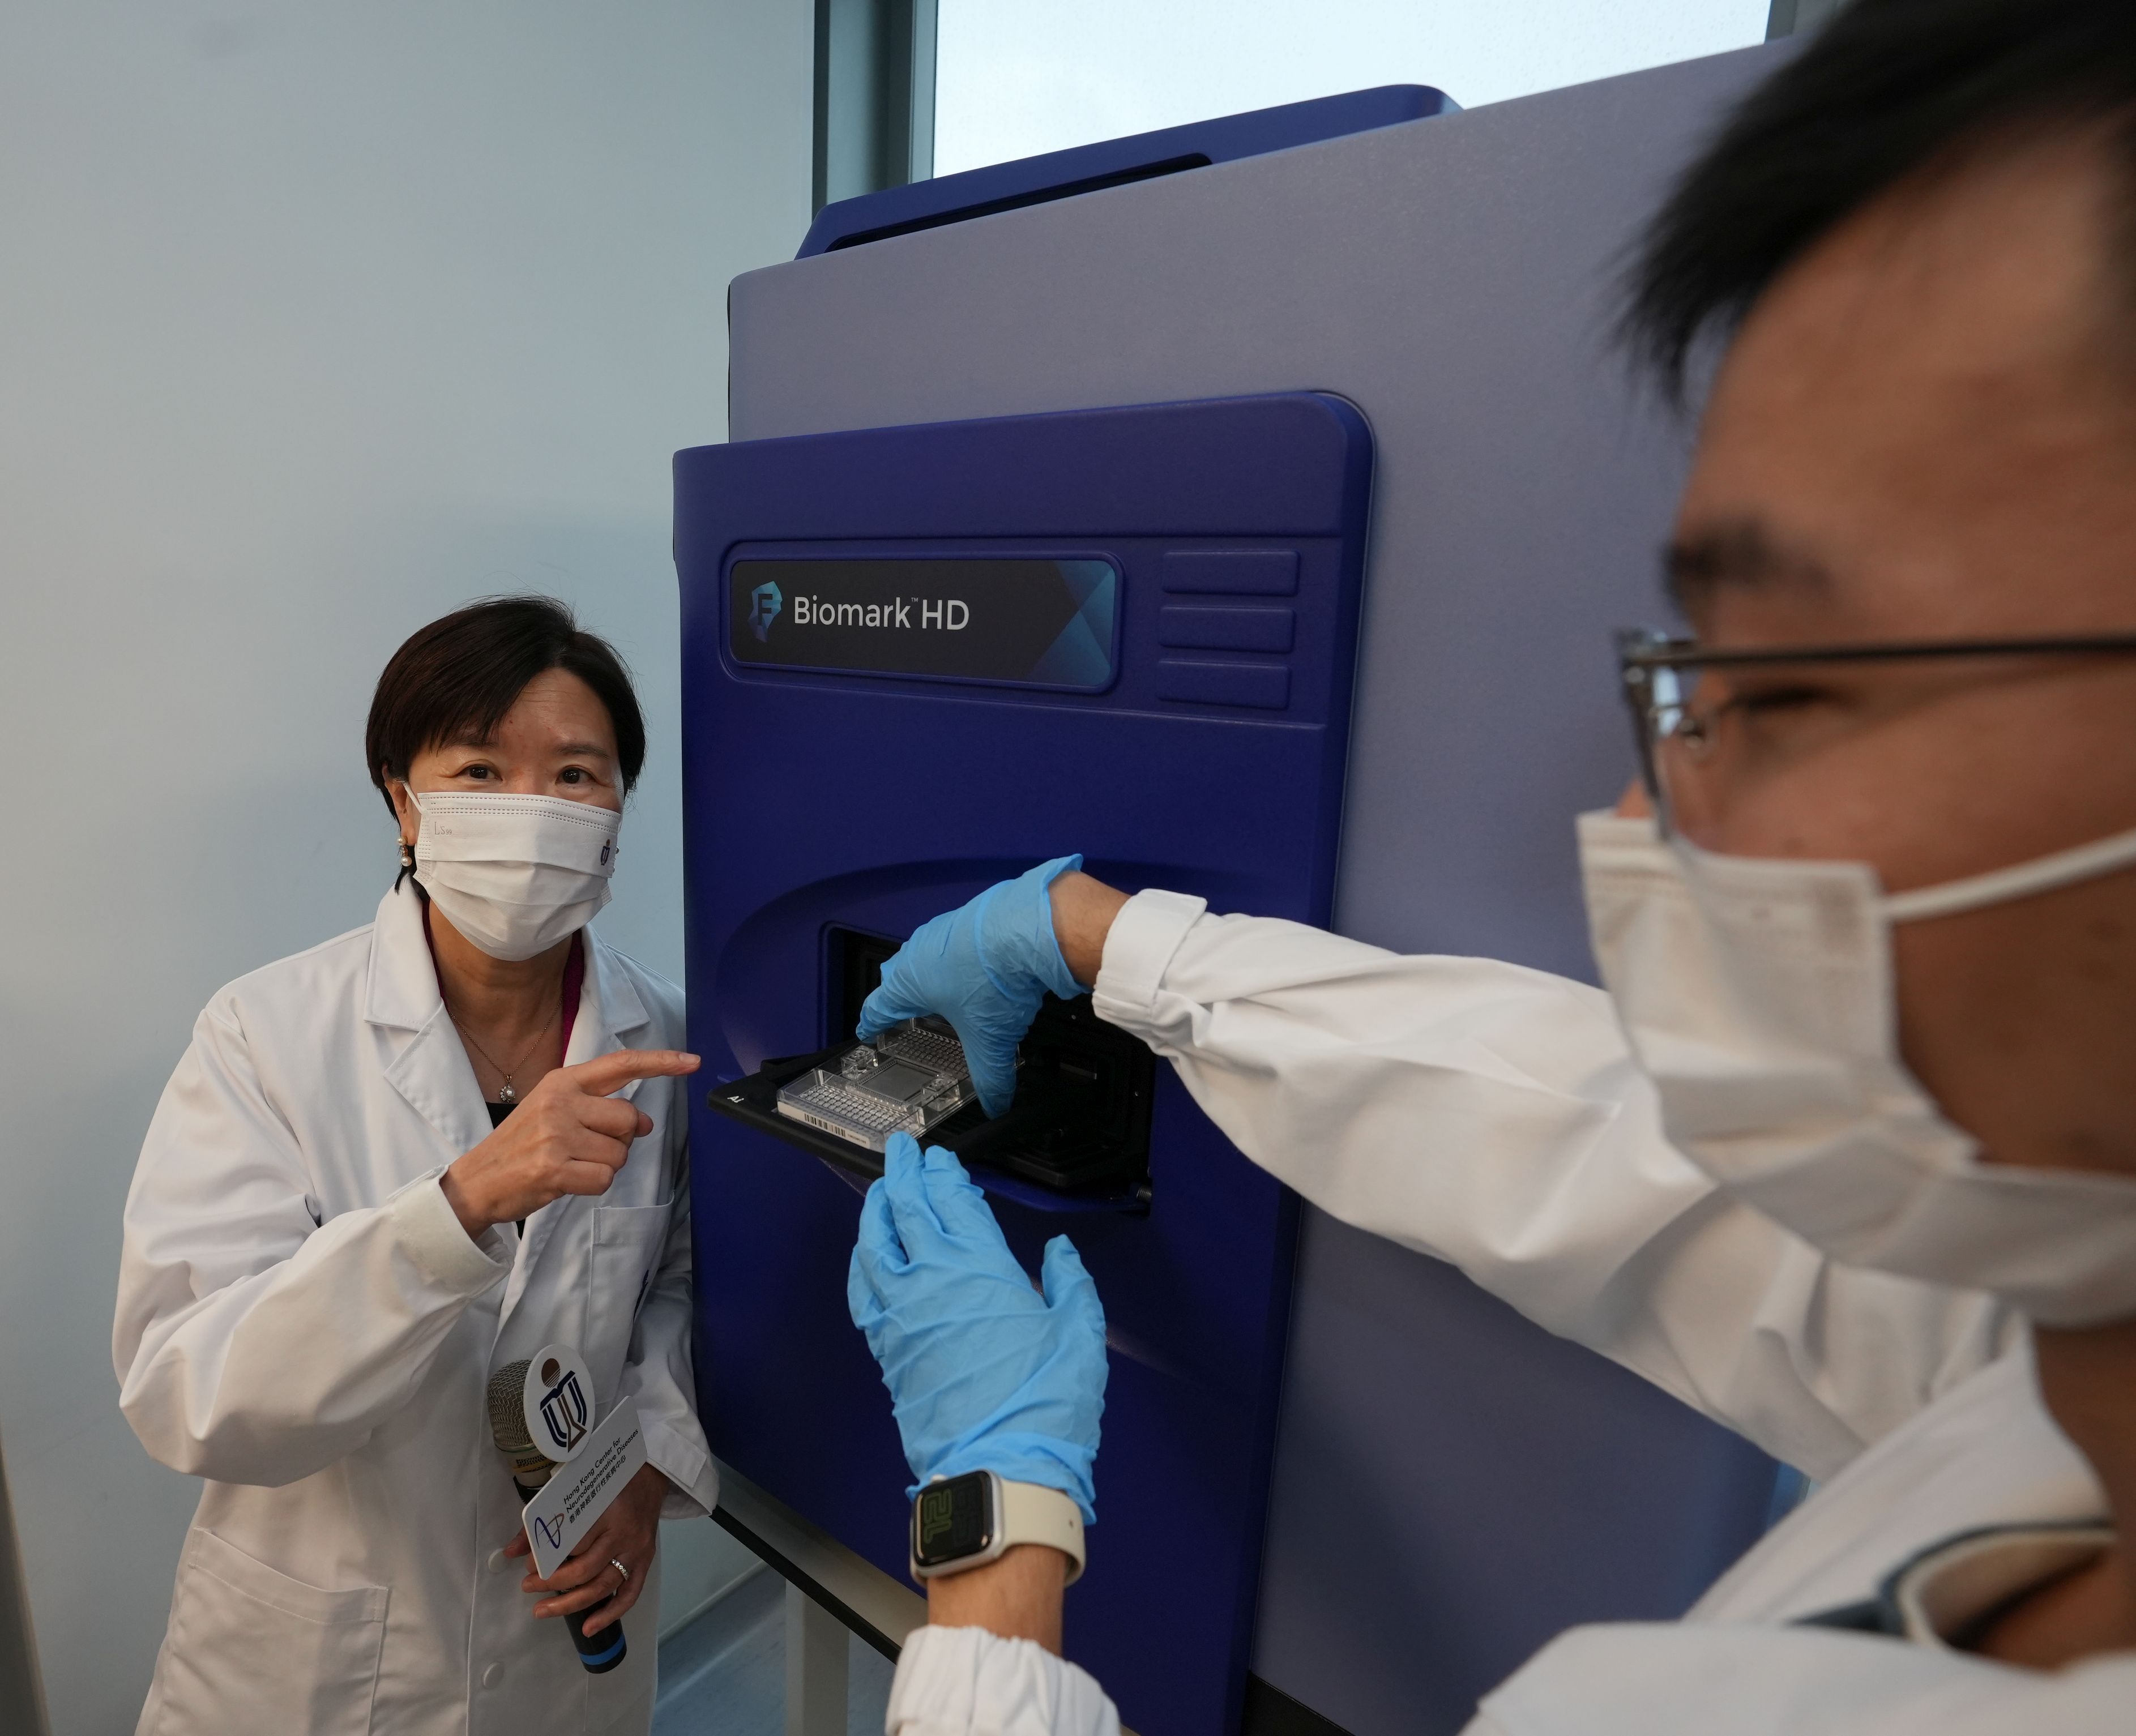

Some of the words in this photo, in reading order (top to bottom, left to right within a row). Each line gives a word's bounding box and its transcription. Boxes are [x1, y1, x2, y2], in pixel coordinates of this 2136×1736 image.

[922, 599, 969, 630] HD
[563, 1485, 579, 1504] Hong
[580, 1468, 595, 1486] Kong
[595, 1447, 612, 1468] Center
[566, 1455, 617, 1513] Neurodegenerative
[617, 1429, 639, 1455] Diseases
